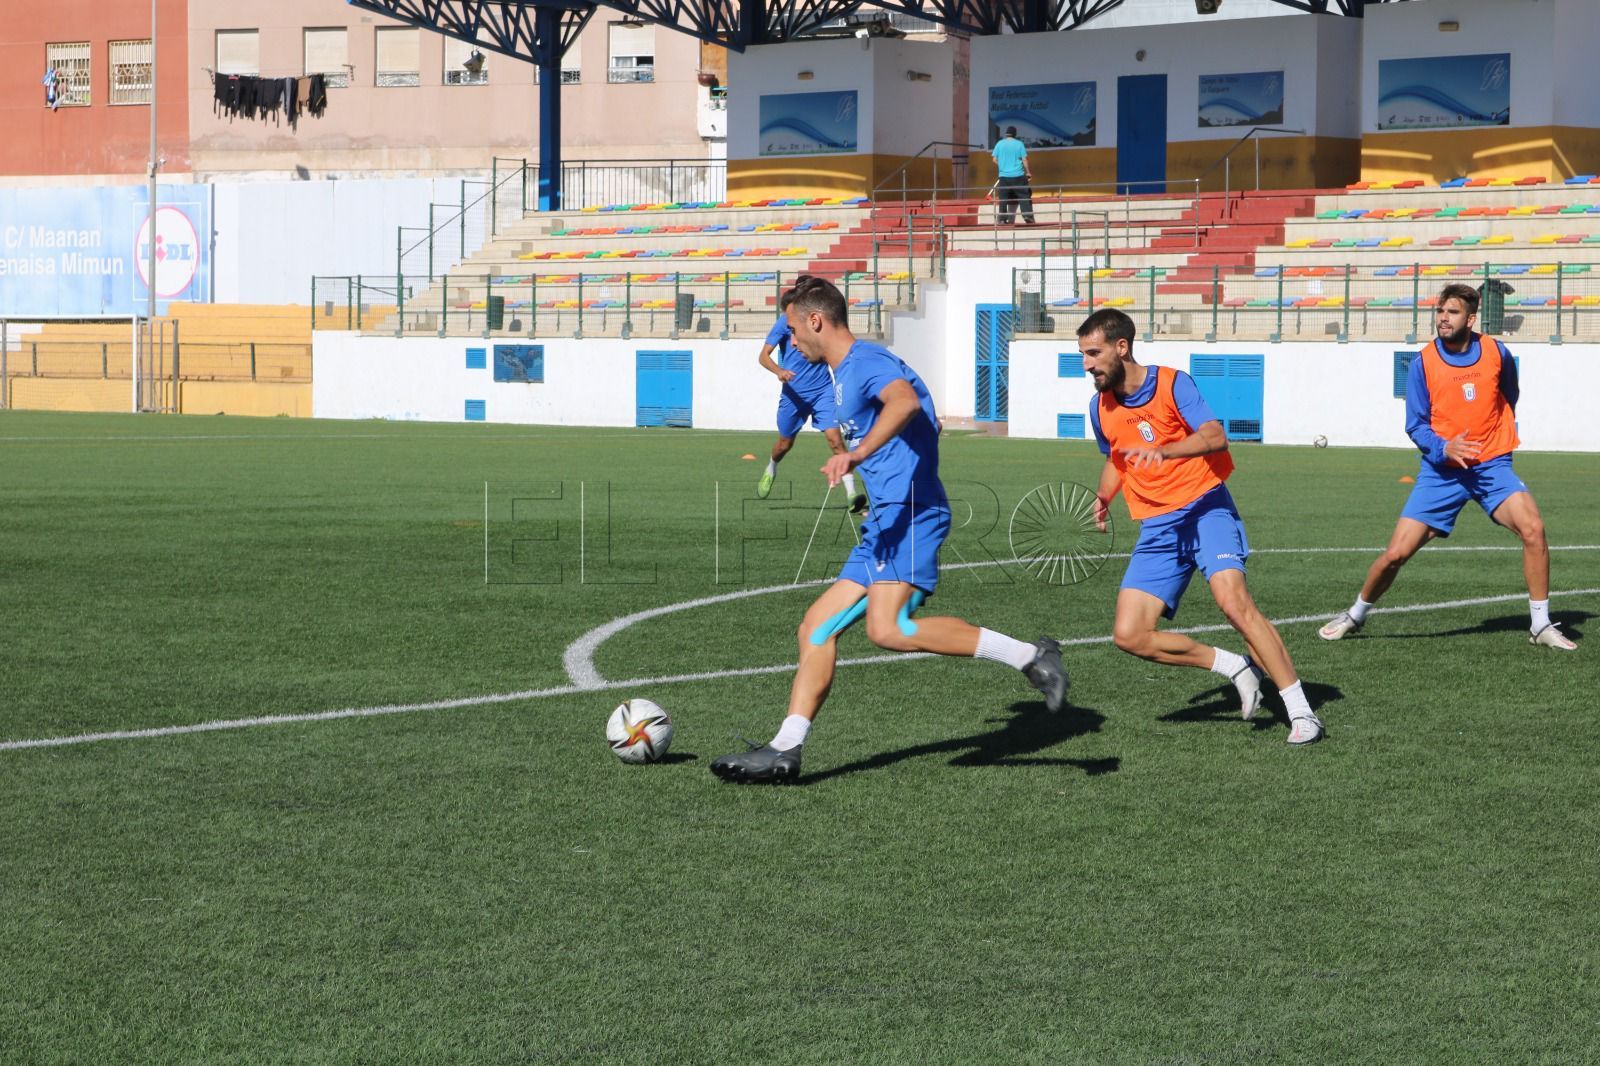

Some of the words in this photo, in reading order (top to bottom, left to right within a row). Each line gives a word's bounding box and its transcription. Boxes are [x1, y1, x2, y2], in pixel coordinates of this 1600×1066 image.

[4, 224, 25, 248] C/
[30, 224, 101, 248] Maanan
[62, 252, 124, 275] Mimun
